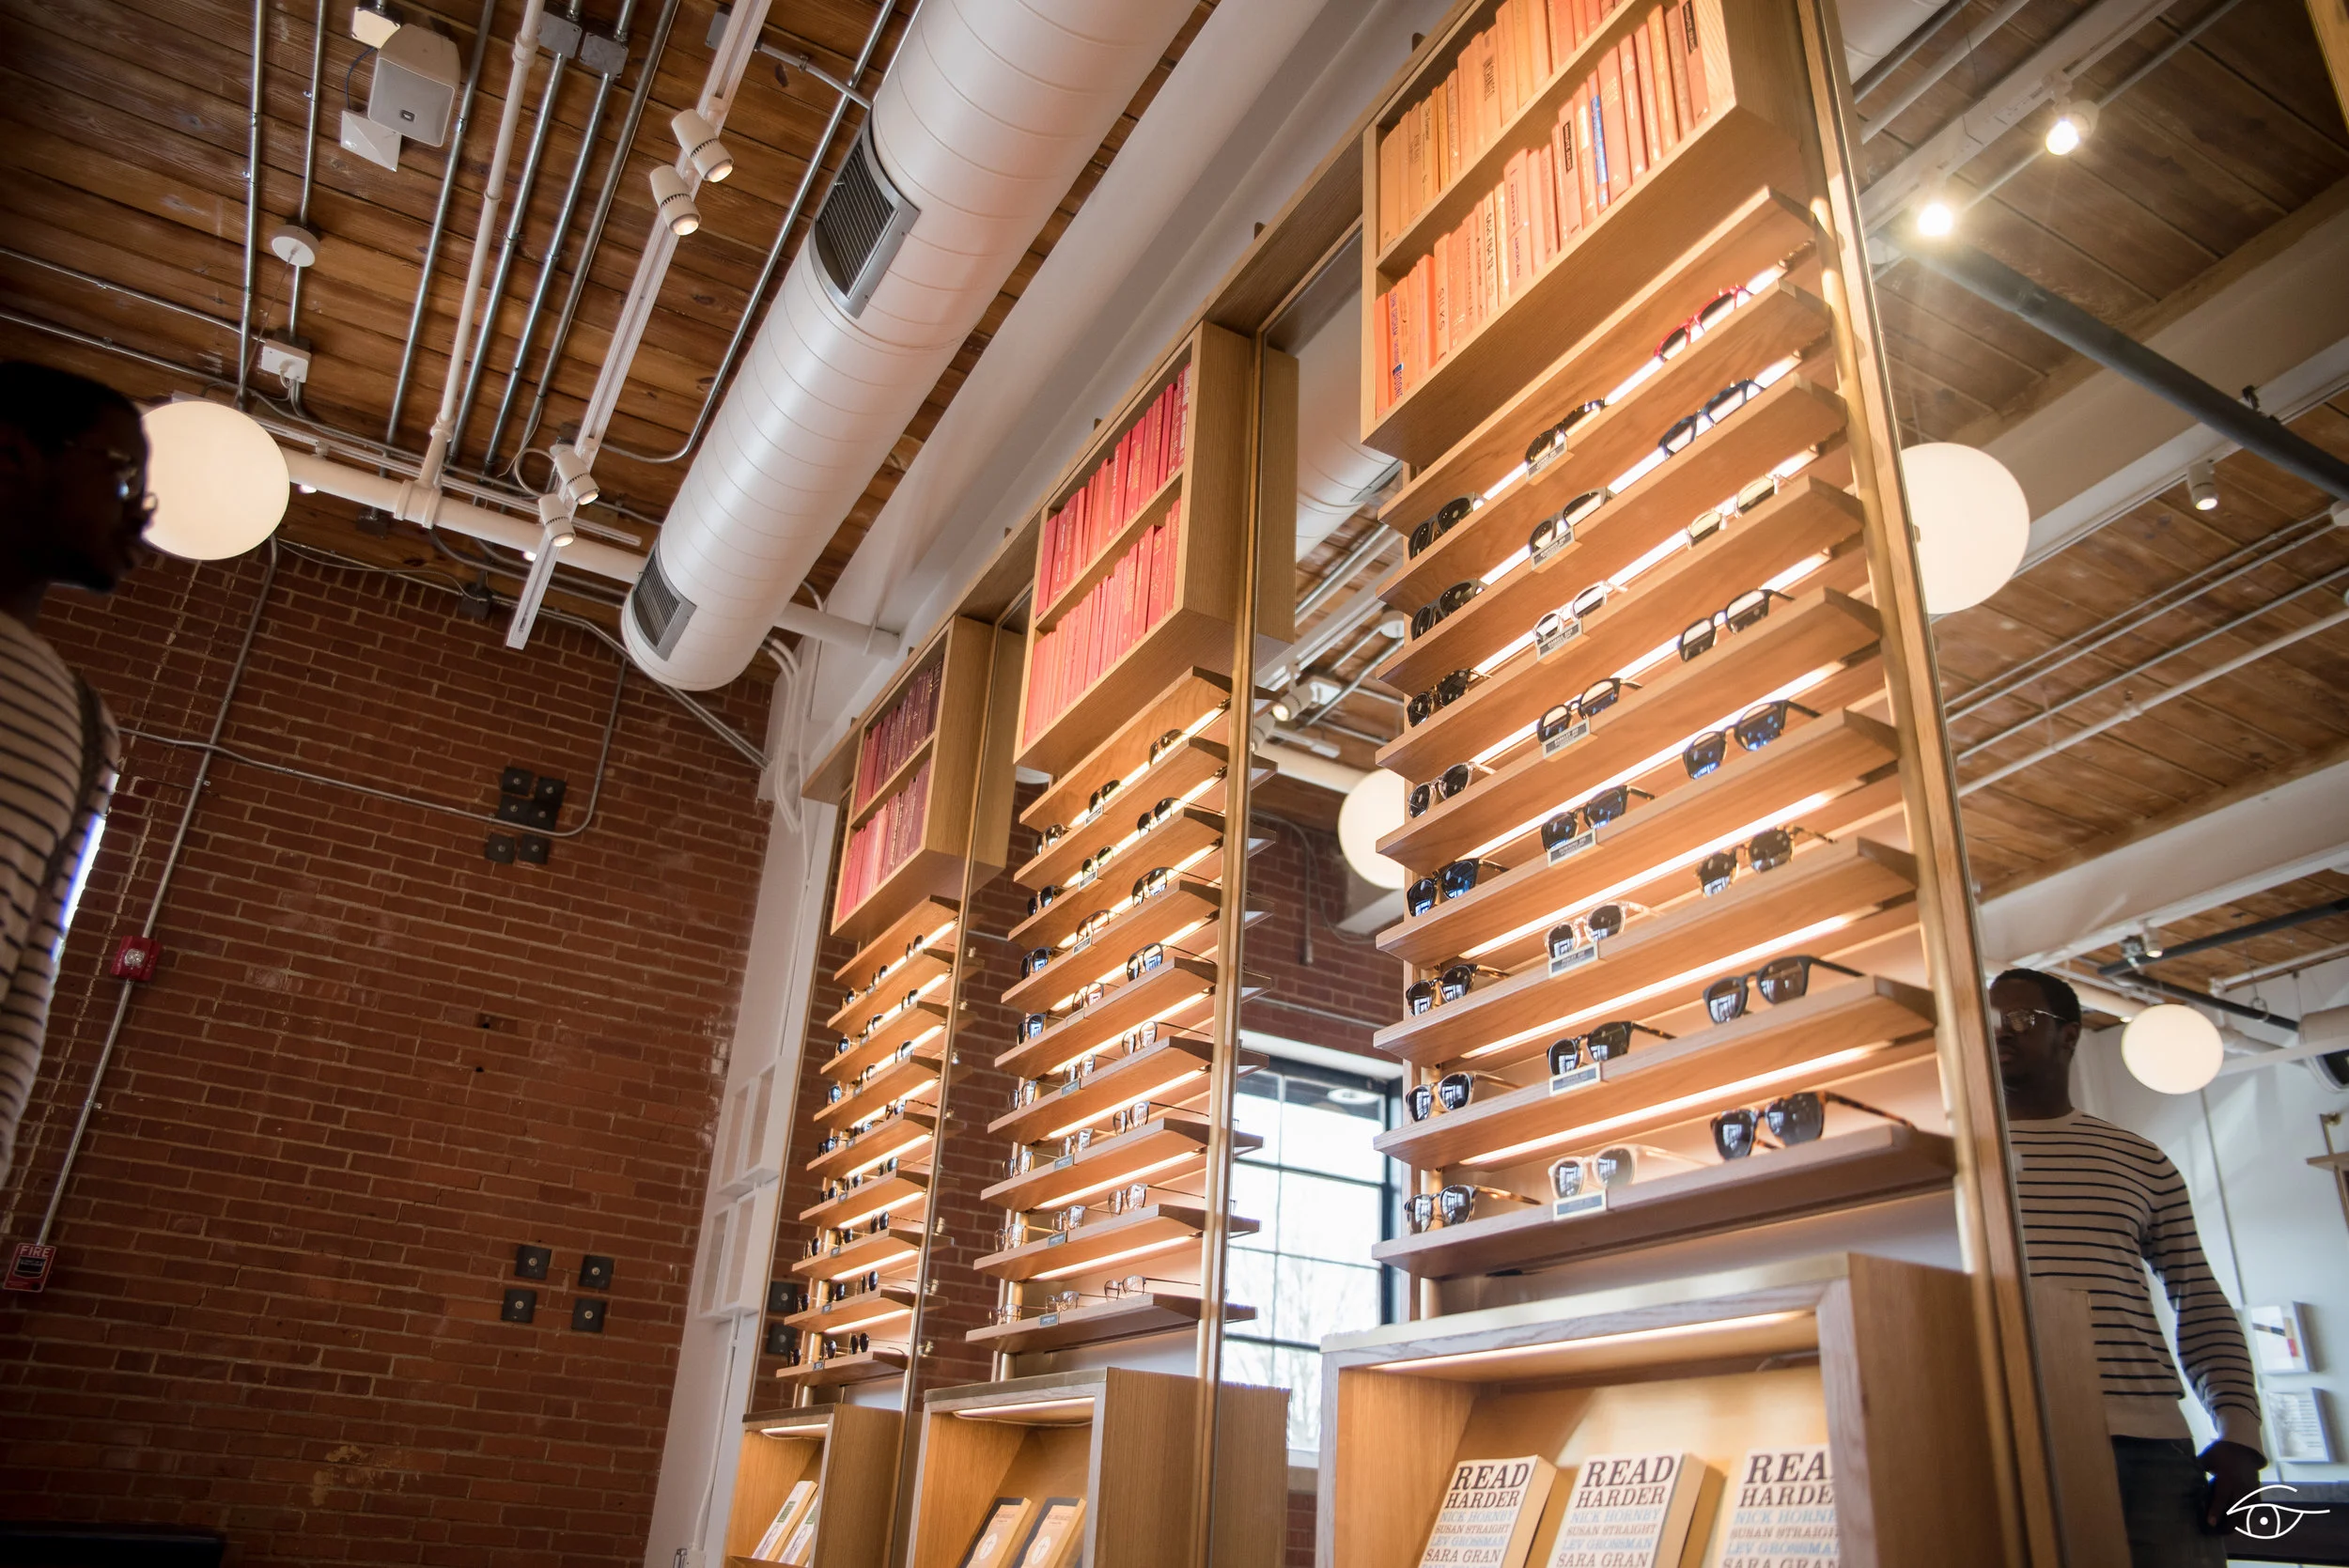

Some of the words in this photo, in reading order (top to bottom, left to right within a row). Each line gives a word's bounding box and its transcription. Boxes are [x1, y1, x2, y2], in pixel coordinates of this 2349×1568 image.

[1393, 370, 1403, 400] BOONE
[20, 1245, 51, 1258] FIRE
[1582, 1455, 1675, 1488] READ
[1744, 1451, 1834, 1484] REA
[1452, 1463, 1530, 1491] READ
[1444, 1490, 1521, 1510] HARDER
[1576, 1485, 1666, 1509] HARDER
[1737, 1484, 1835, 1508] HARDE
[1440, 1511, 1467, 1523] NICK
[1468, 1509, 1515, 1522] HORNBY
[1569, 1510, 1601, 1524] NICK
[1603, 1508, 1661, 1522] HORNBY
[1734, 1510, 1773, 1524] NICK
[1435, 1524, 1464, 1534] SUSAN
[1465, 1524, 1512, 1534] STRAIGHT
[1566, 1525, 1600, 1536] SUSAN
[1601, 1523, 1658, 1536] STRAIGHT
[1429, 1535, 1451, 1547] LEV
[1451, 1534, 1507, 1547] GROSSMAN
[1562, 1538, 1585, 1551] LEV
[1585, 1537, 1655, 1550] GROSSMAN
[1424, 1548, 1459, 1563] SARA
[1462, 1548, 1501, 1563] GRAN
[1726, 1542, 1753, 1555] LEV
[1555, 1552, 1597, 1568] SARA
[1600, 1552, 1650, 1568] GRAN
